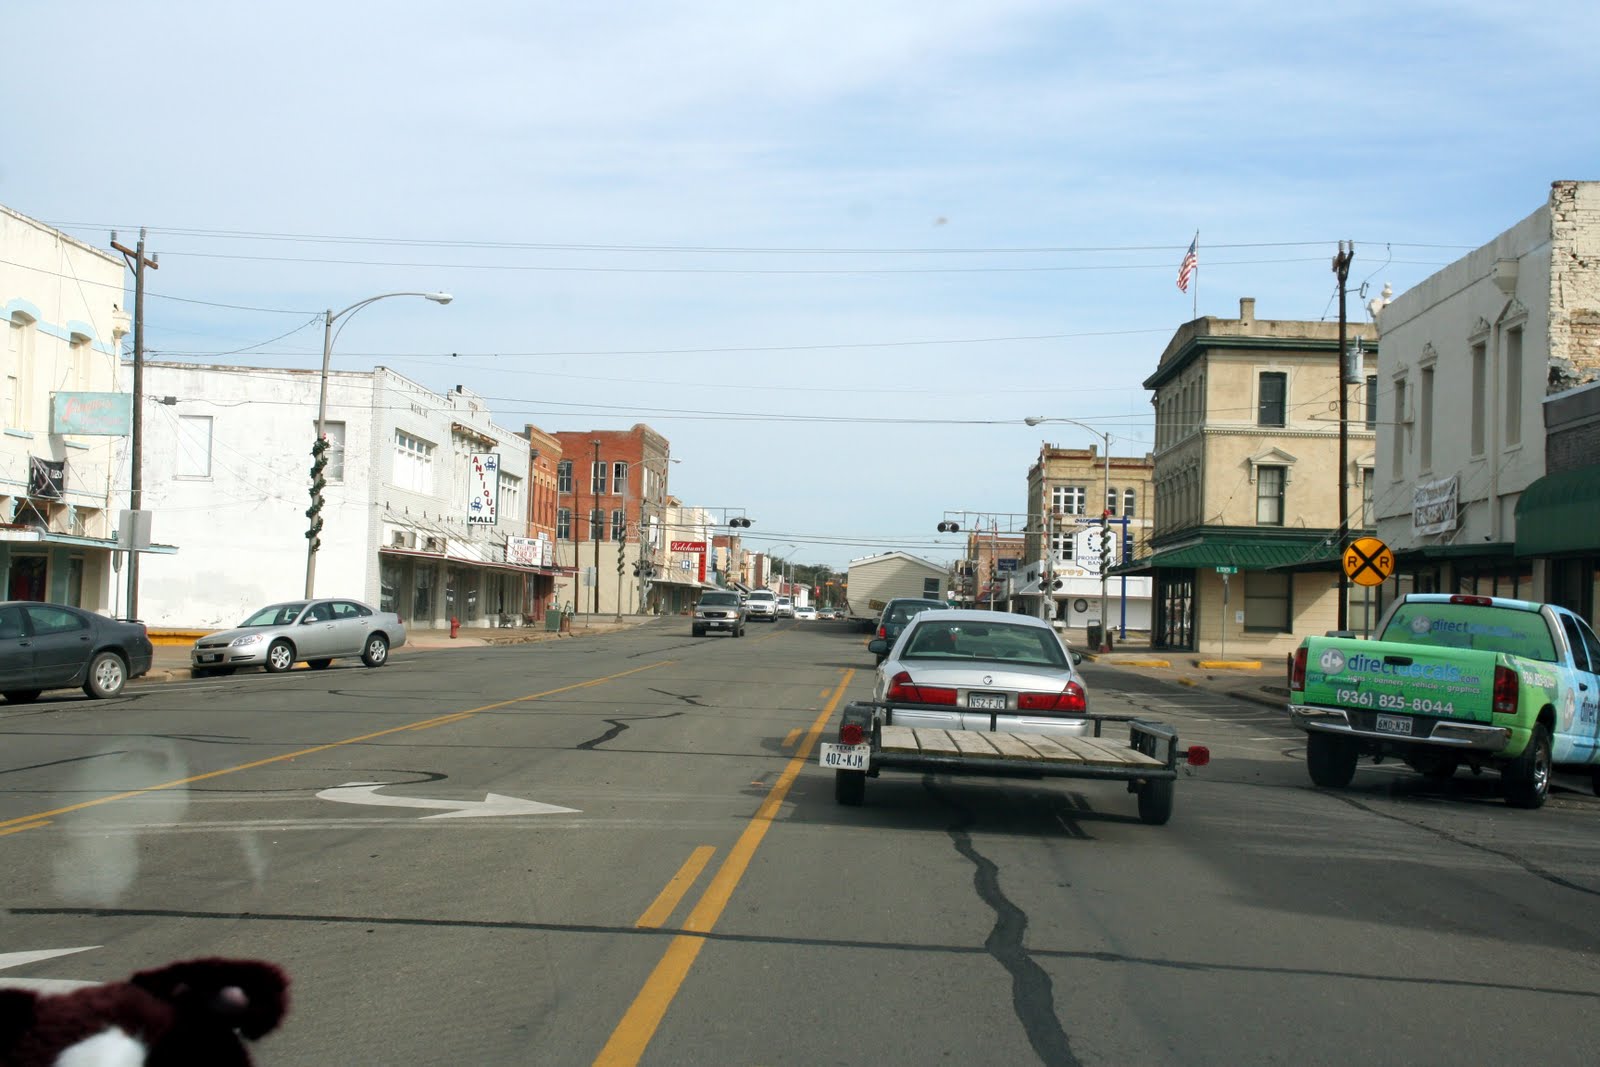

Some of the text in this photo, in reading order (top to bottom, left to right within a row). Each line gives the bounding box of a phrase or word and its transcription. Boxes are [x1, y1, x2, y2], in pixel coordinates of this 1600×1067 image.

[472, 456, 495, 515] ANTIQUE
[671, 542, 705, 551] Ketchum's
[1347, 556, 1390, 568] R R
[1347, 675, 1481, 694] signs banners vehicle graphics
[1336, 688, 1454, 715] (936) 825-8044
